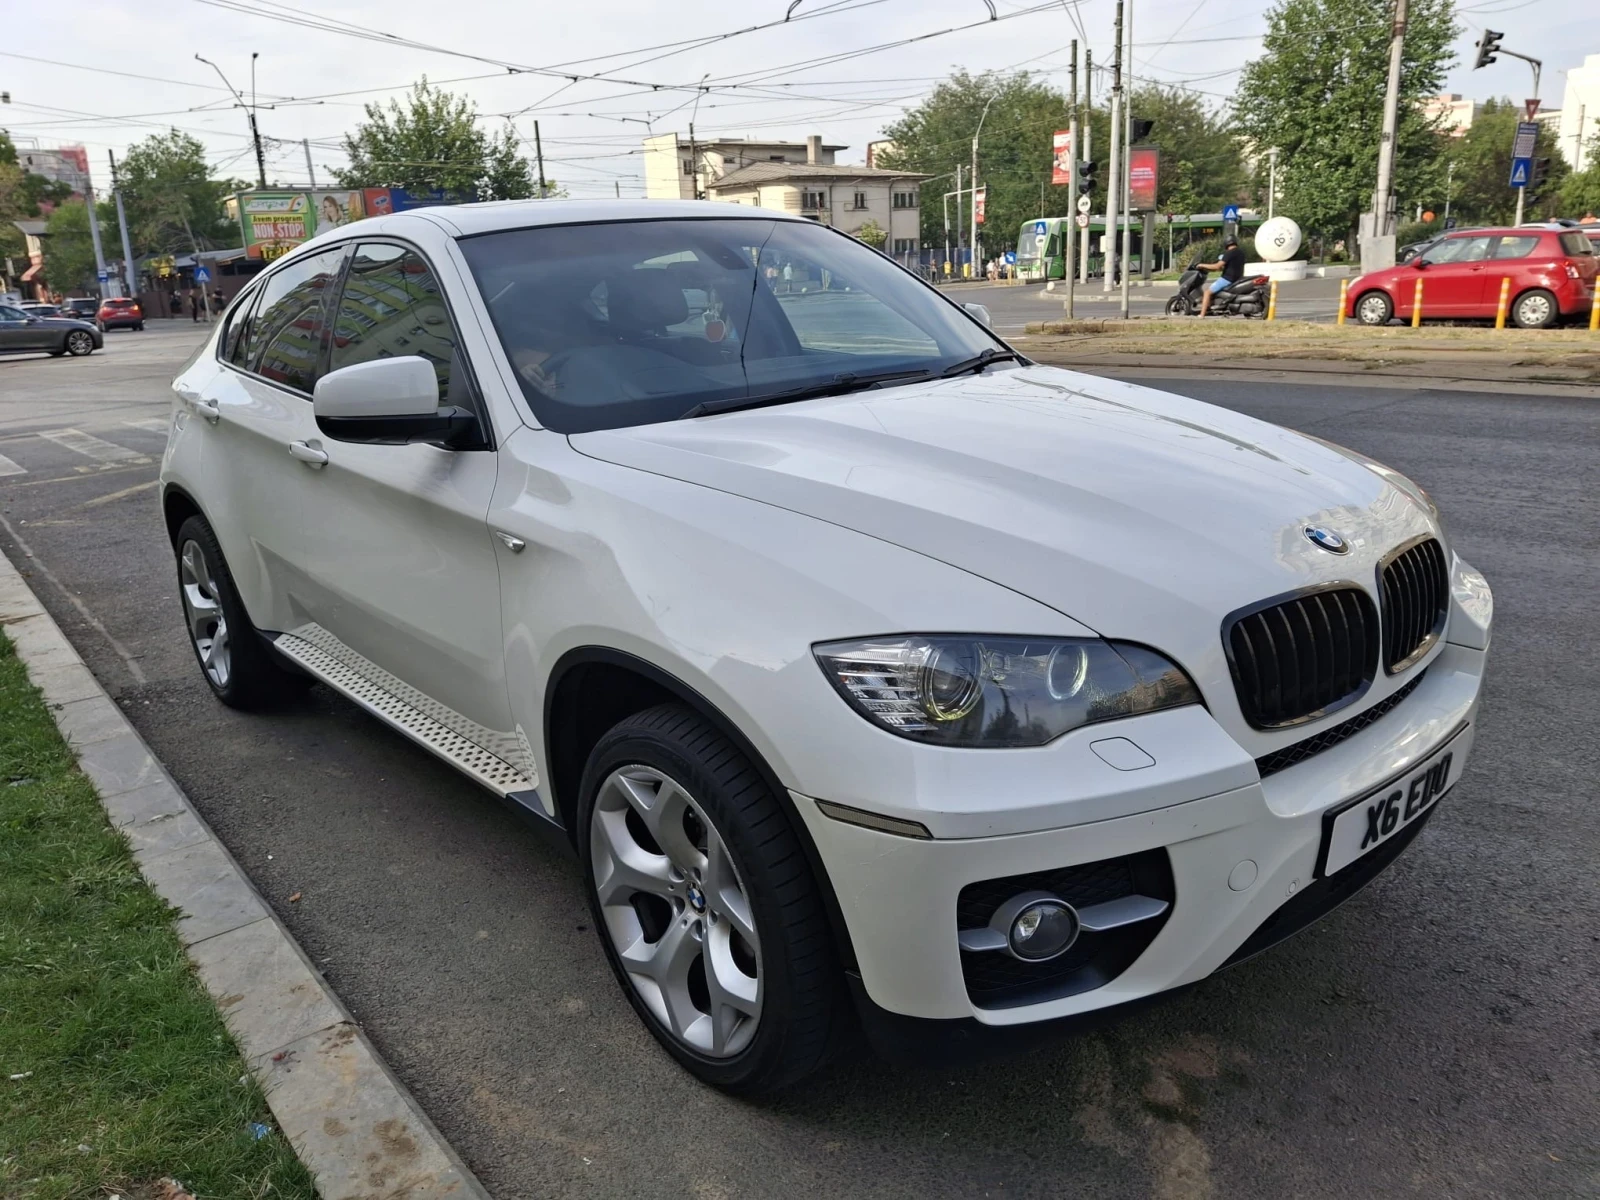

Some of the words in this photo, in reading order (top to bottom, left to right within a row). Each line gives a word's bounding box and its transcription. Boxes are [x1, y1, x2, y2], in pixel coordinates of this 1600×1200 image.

[253, 224, 305, 238] NON-STOP!
[1361, 790, 1403, 849] X6
[1404, 751, 1453, 821] EDO
